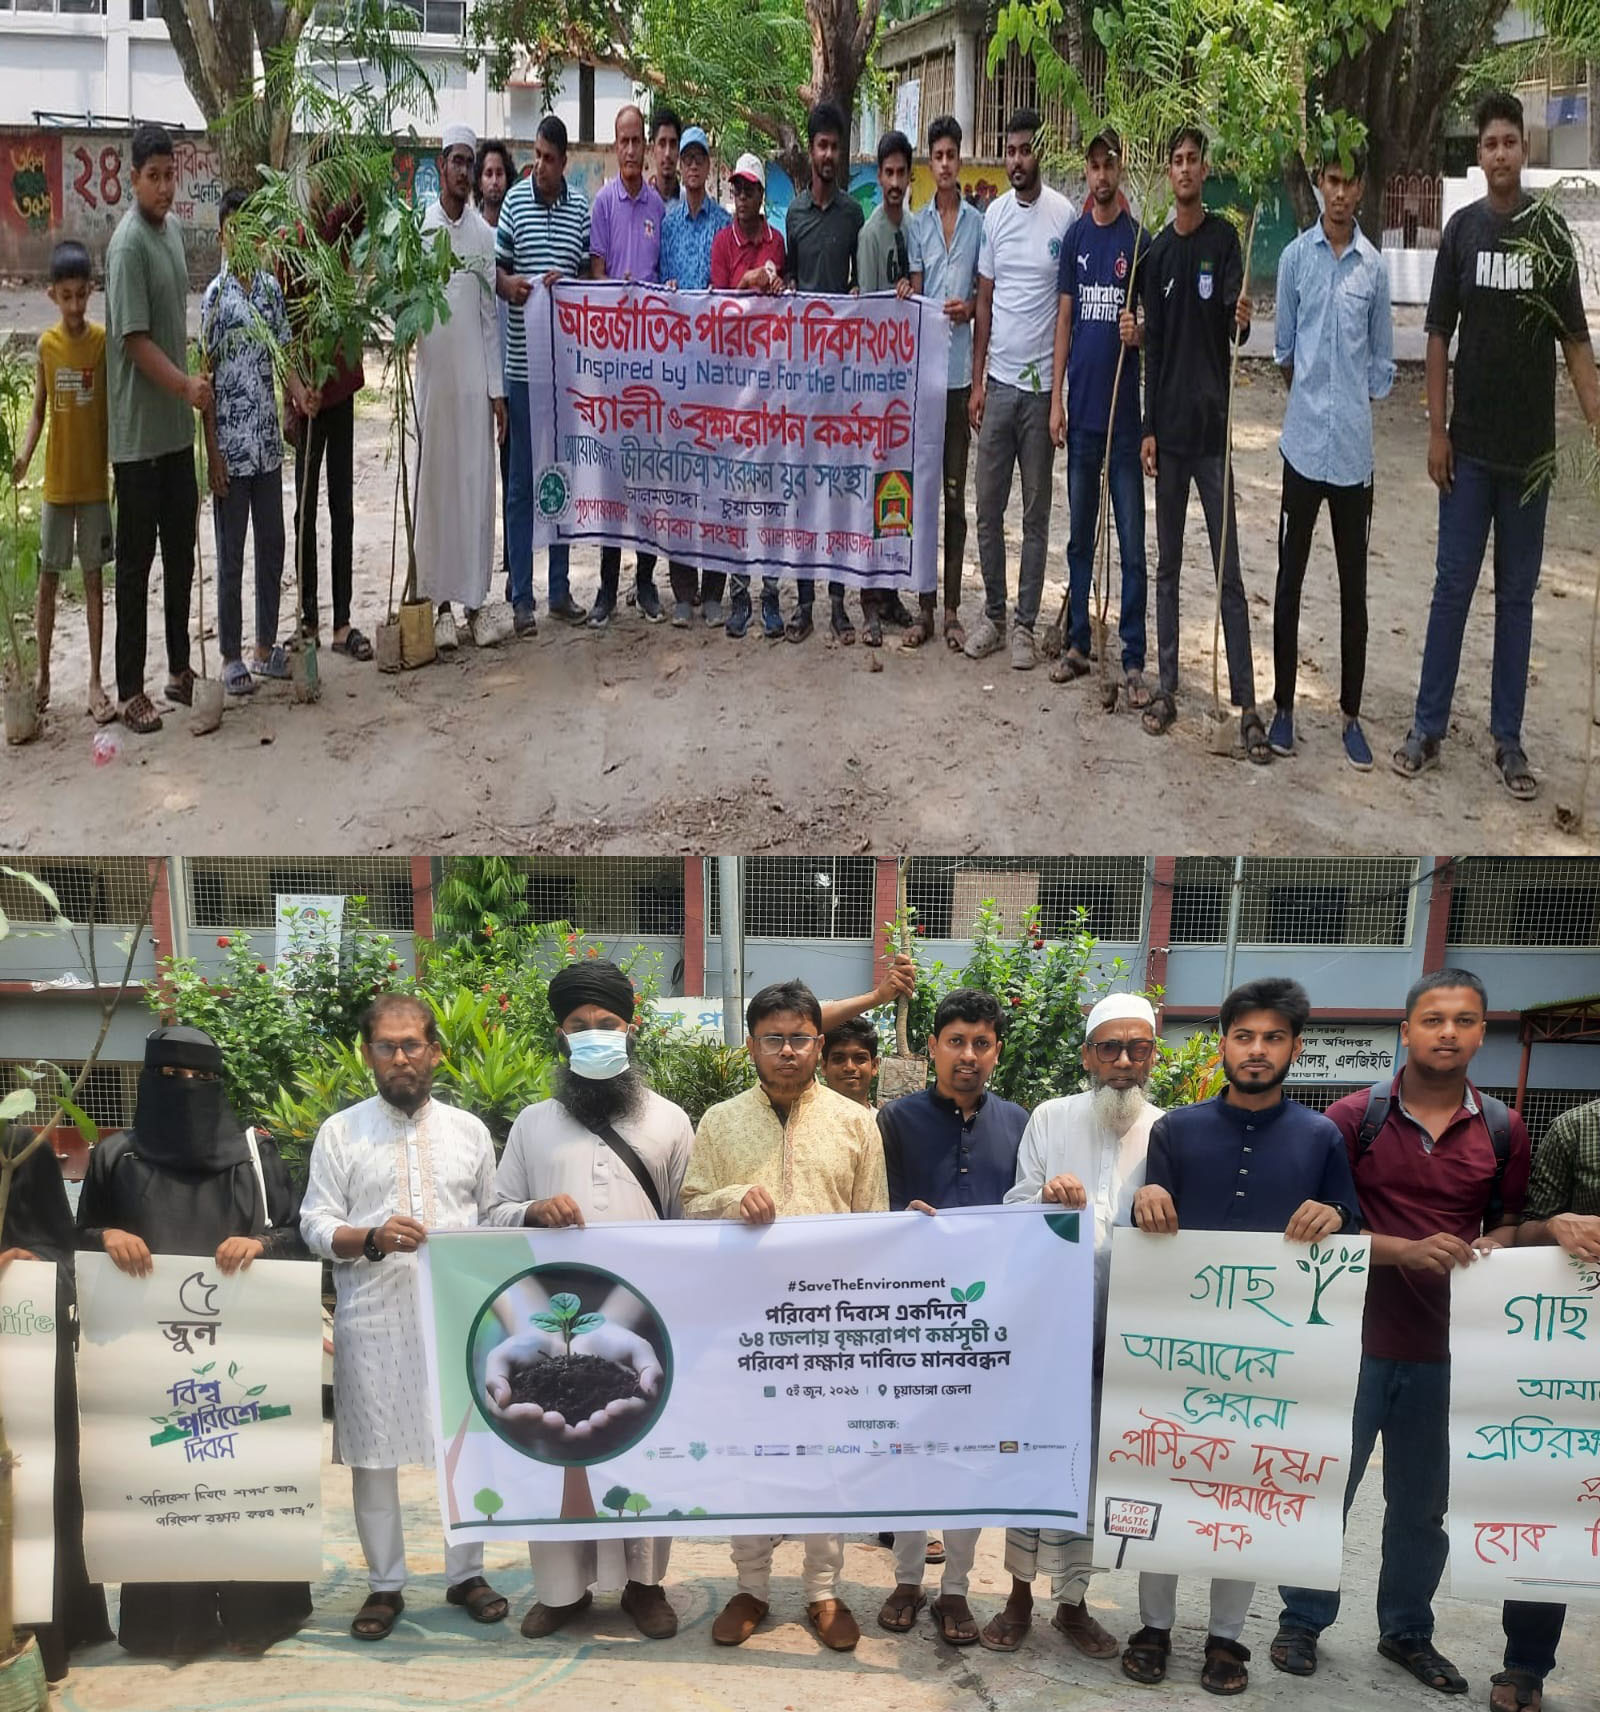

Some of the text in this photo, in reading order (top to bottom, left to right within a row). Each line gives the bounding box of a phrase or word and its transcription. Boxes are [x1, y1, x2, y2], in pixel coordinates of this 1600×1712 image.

[73, 146, 121, 210] ২৪
[555, 295, 691, 352] আন্তর্জাতিক
[695, 301, 797, 361] পরিবেশ
[662, 361, 686, 390] by
[807, 369, 835, 394] the
[812, 400, 911, 460] কর্মসূচি
[1322, 1036, 1373, 1048] অধিদপ্তর
[1335, 1051, 1393, 1071] এলজিইডি
[788, 1277, 946, 1292] #SaveTheEnvironment
[1190, 1264, 1294, 1327] গাছ
[0, 1300, 55, 1336] ife
[765, 1298, 967, 1324] পরিবেশ দিবসে একদিনে
[1504, 1293, 1593, 1342] গাছ
[158, 1321, 222, 1354] জুন
[739, 1319, 1008, 1351] ৬৪ জেলায় বৃক্ষরোপণ কর্মসূচী ও
[738, 1347, 1011, 1372] পরিবেশ রক্ষার দাবিতে মানববন্ধন
[1120, 1333, 1295, 1382] আমাদের
[166, 1379, 222, 1407] বিশ্ব
[803, 1386, 826, 1399] জুন,
[830, 1387, 859, 1395] ২০২৬
[893, 1384, 972, 1399] চুয়াডাঙ্গা জেলা
[1517, 1379, 1600, 1401] আমা
[177, 1401, 260, 1437] পরিবেশ
[848, 1420, 900, 1430] আয়োজক:
[1109, 1408, 1236, 1472] প্লাস্টিক
[1121, 1502, 1149, 1515] STOP
[1170, 1477, 1316, 1527] আমাদের
[1110, 1524, 1148, 1535] POLLUTION
[1111, 1513, 1149, 1527] PLASTIC
[1474, 1522, 1557, 1564] হোক
